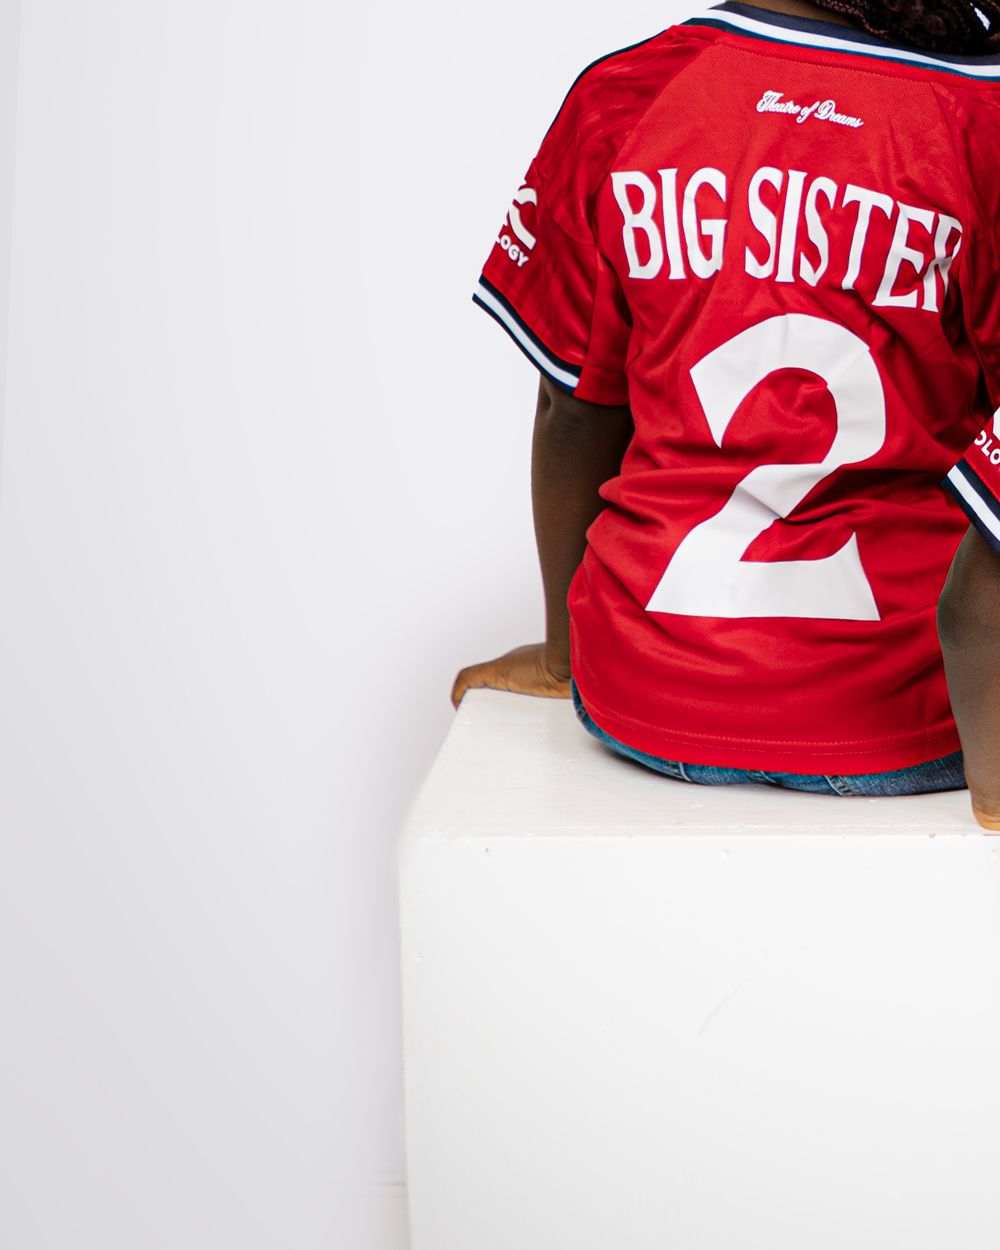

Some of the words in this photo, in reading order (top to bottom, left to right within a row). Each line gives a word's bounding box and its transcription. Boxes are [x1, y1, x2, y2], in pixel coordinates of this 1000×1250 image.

[756, 89, 802, 115] Theatre
[796, 100, 821, 124] of
[813, 99, 865, 128] Dreams
[610, 167, 728, 280] BIG
[744, 166, 964, 313] SISTER
[644, 312, 887, 621] 2
